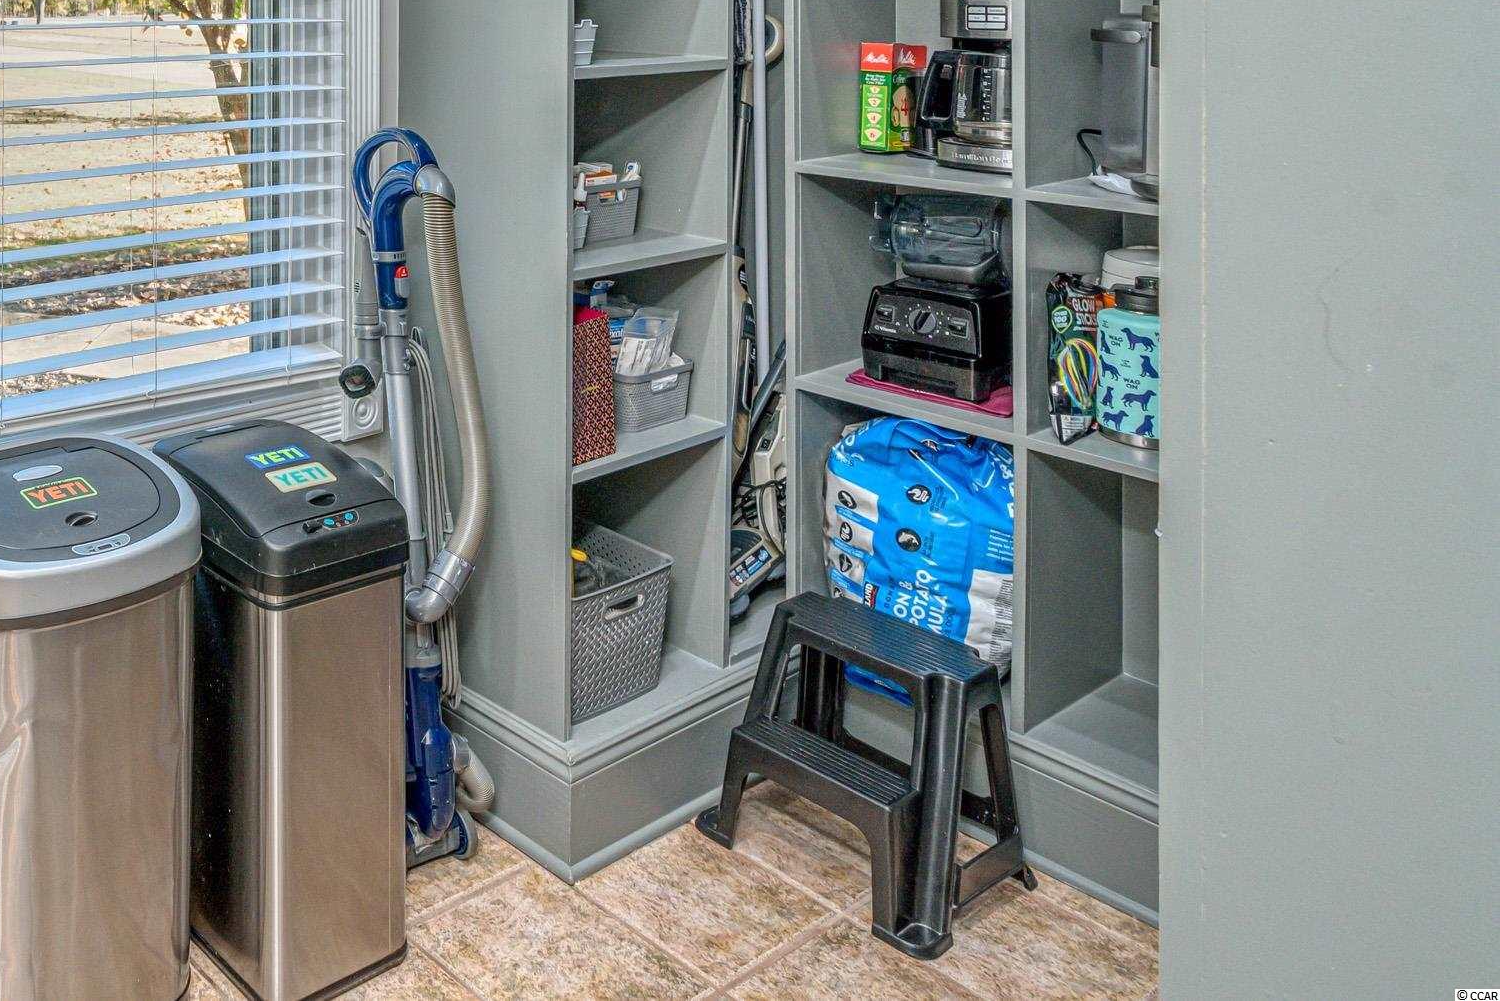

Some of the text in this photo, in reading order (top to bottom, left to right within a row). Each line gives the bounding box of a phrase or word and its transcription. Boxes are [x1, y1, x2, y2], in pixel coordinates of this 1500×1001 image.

[901, 102, 909, 117] 4
[1075, 311, 1098, 326] STICK
[1108, 334, 1125, 344] WAG
[1123, 377, 1141, 386] WAG
[249, 448, 306, 465] YETI
[274, 465, 329, 487] YETI
[27, 482, 91, 504] YETI
